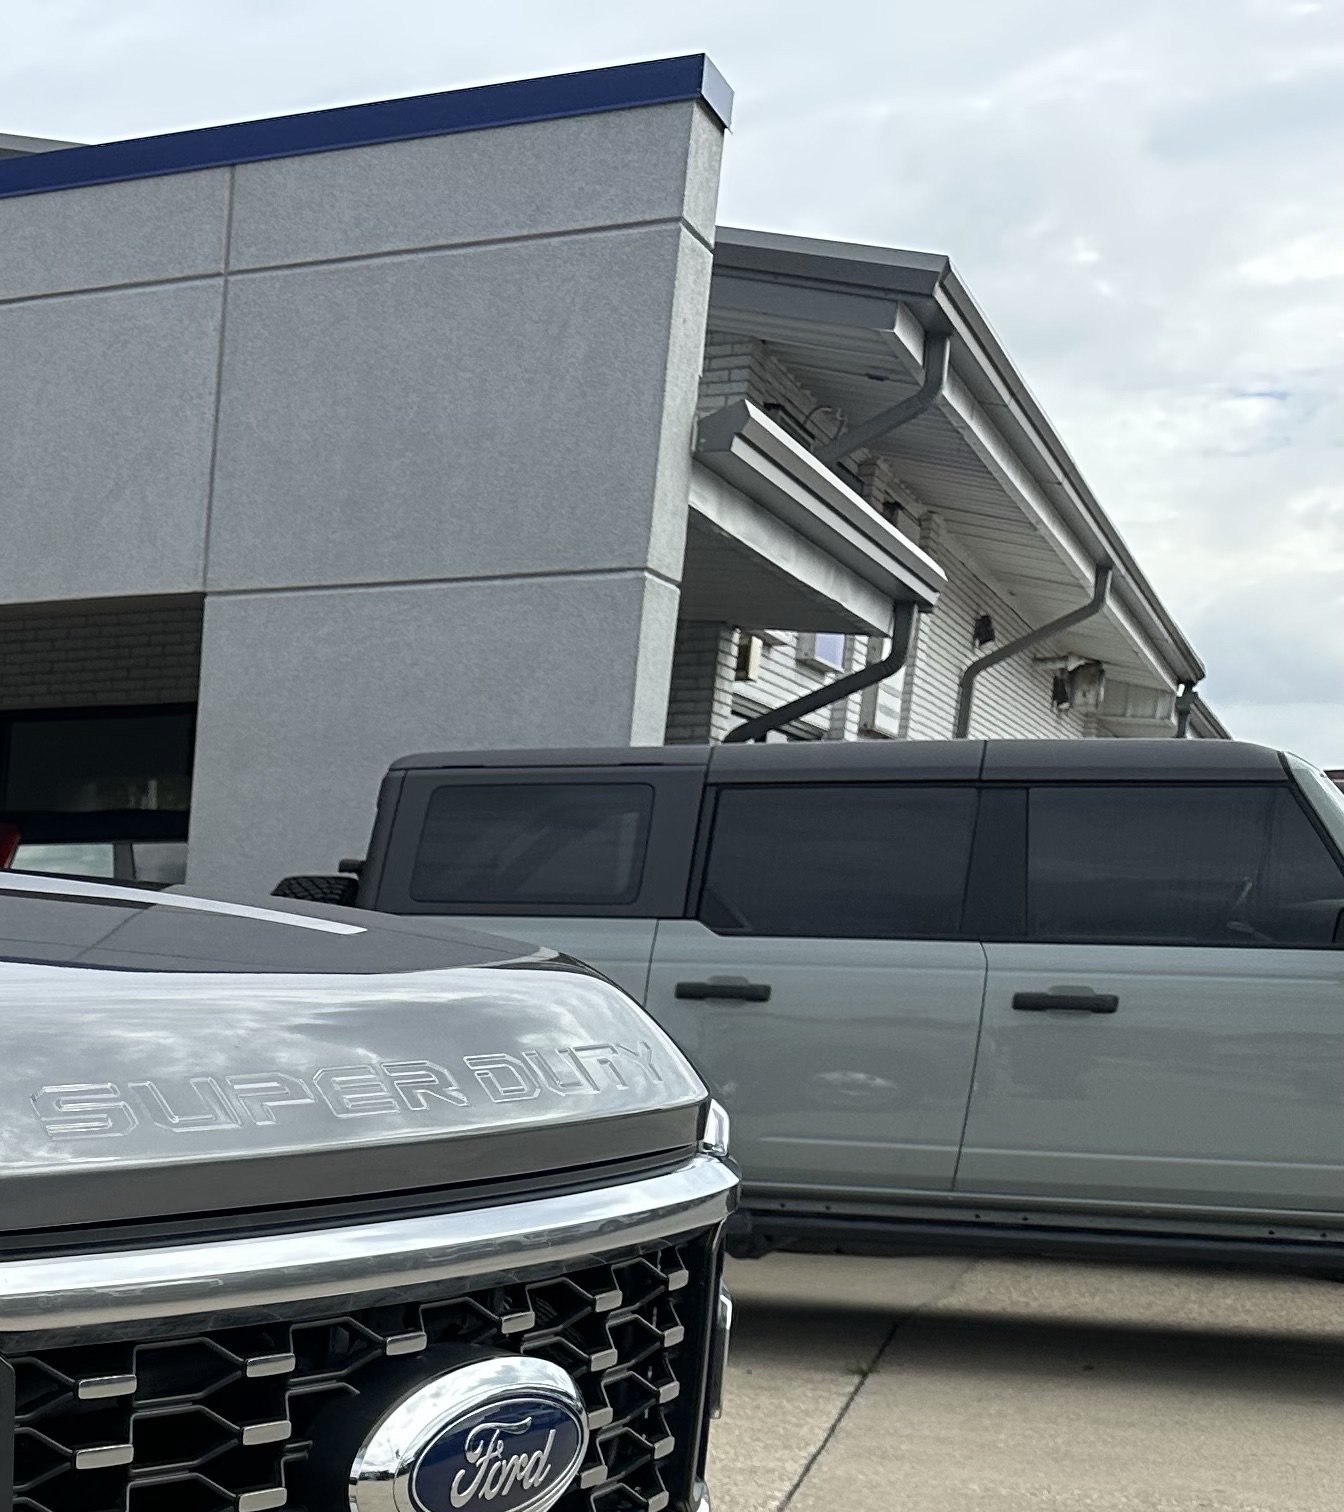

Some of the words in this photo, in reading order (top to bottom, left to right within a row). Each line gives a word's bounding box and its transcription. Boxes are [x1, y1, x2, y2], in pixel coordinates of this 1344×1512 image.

[30, 1058, 469, 1140] SUPER
[463, 1040, 663, 1104] DUTY
[450, 1416, 557, 1509] Ford
